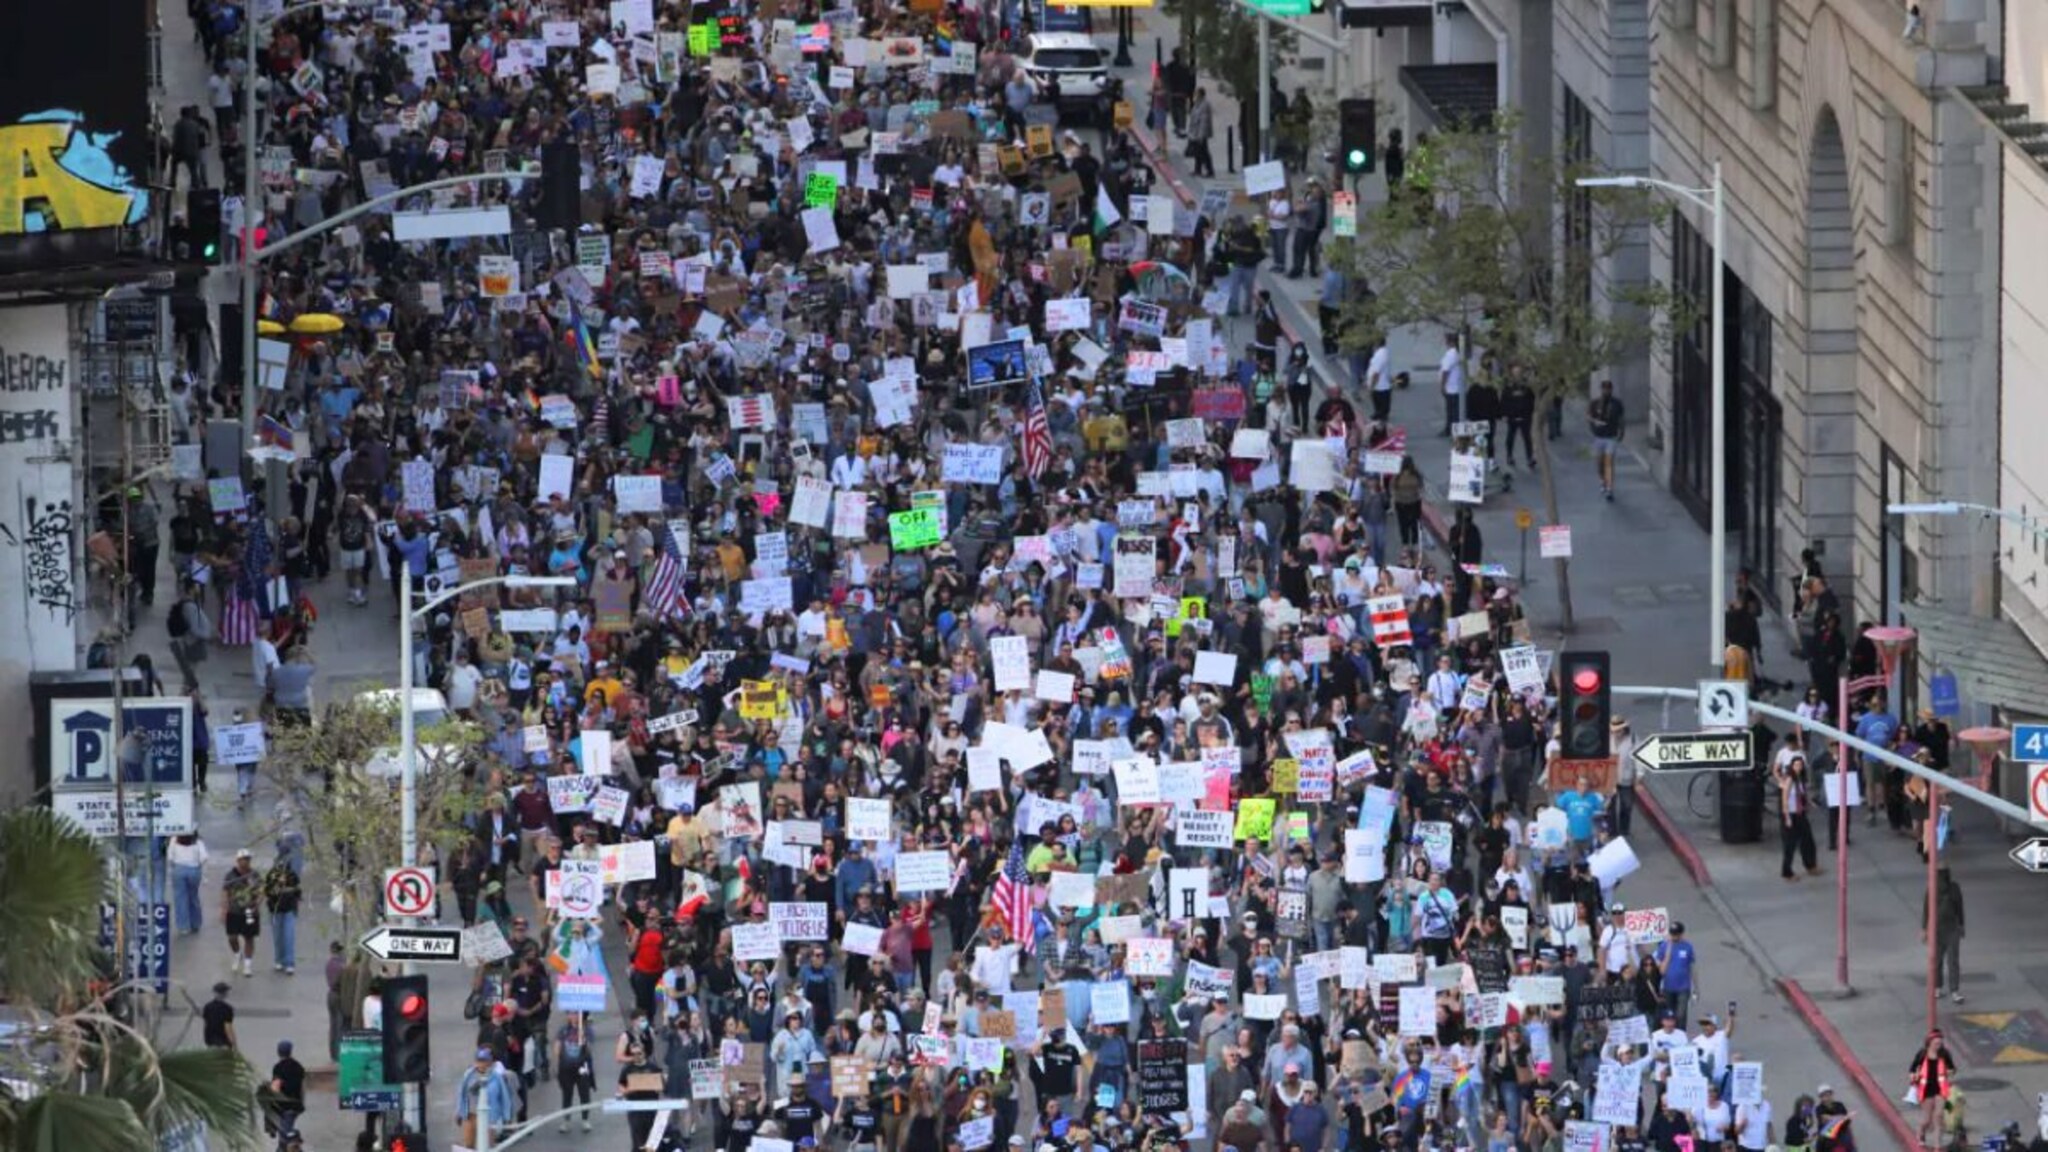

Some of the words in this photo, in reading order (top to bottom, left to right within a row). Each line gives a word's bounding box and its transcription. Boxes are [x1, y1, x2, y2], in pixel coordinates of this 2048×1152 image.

[76, 729, 102, 778] P
[1659, 745, 1693, 761] ONE
[1705, 742, 1741, 760] WAY
[77, 801, 112, 811] STATE
[390, 938, 418, 951] ONE
[423, 937, 450, 952] WAY
